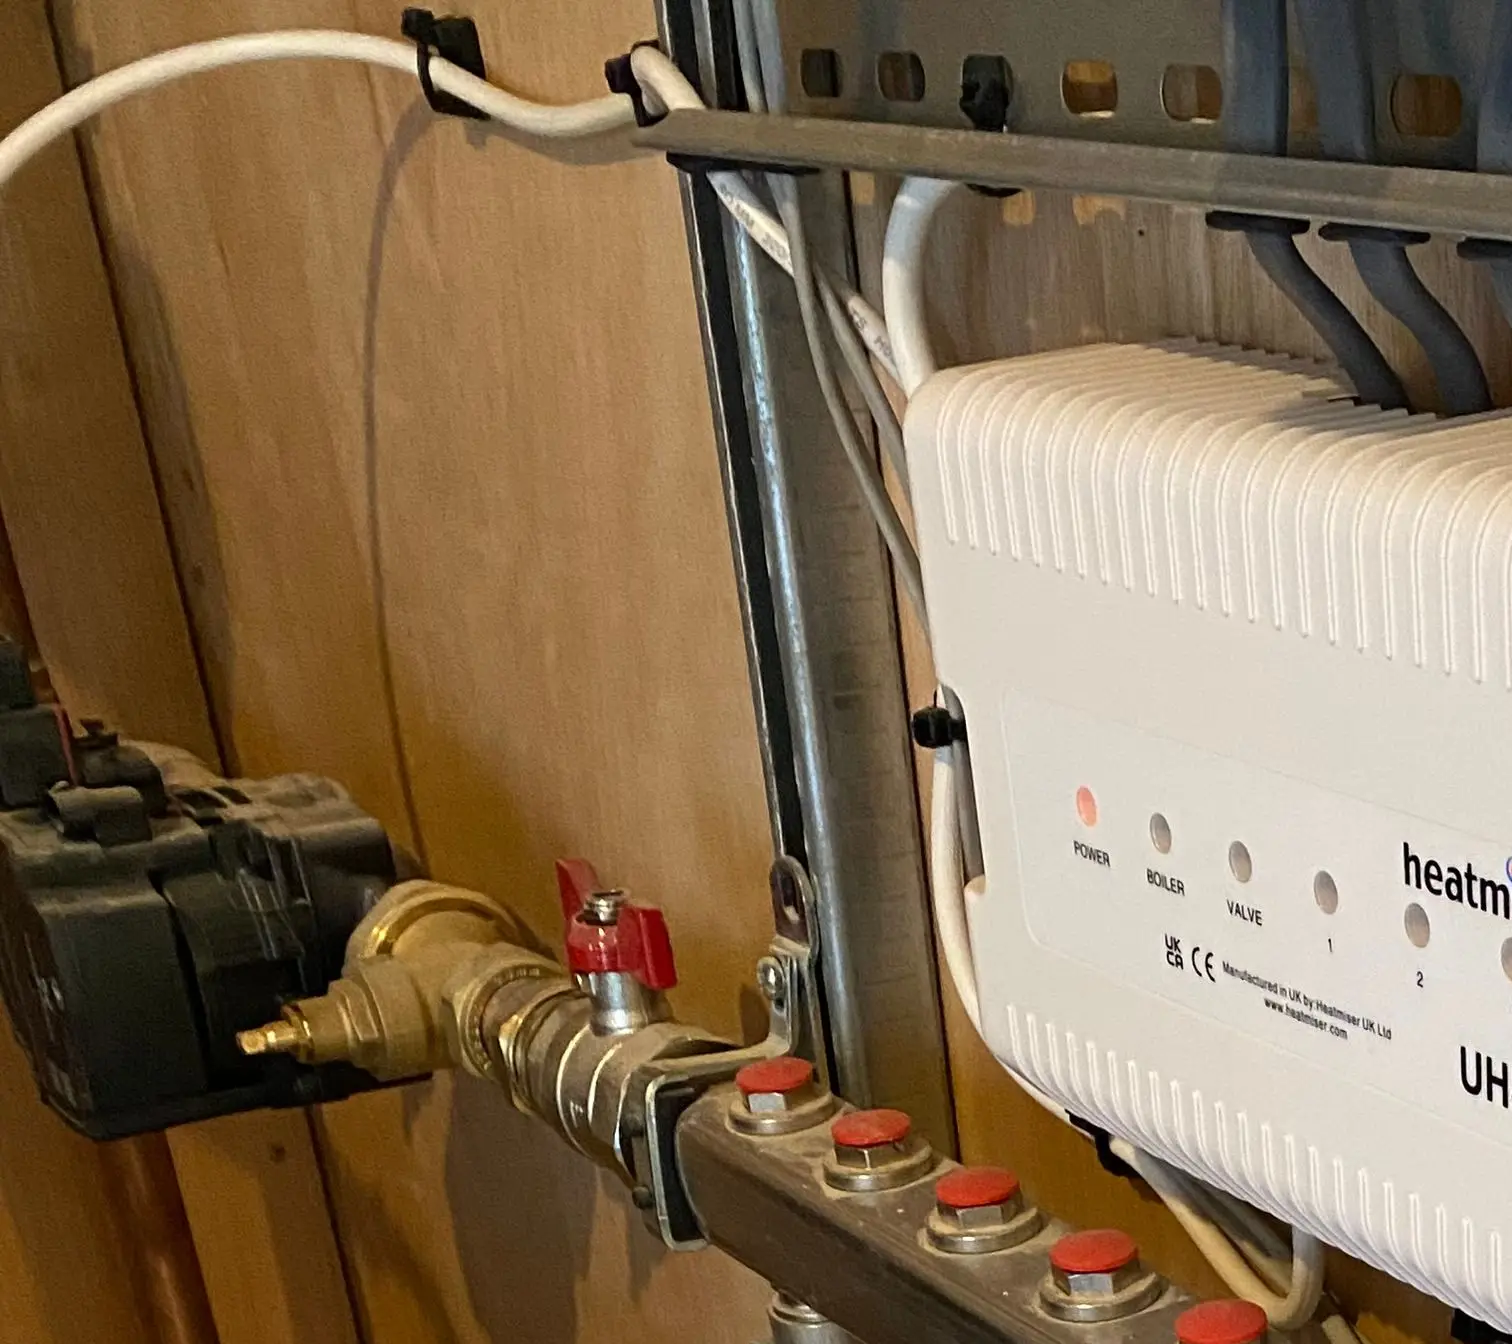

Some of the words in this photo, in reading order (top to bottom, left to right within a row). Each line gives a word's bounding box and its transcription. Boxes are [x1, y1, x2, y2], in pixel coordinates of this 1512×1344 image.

[1073, 840, 1112, 868] POWER
[1146, 867, 1185, 897] BOILER
[1226, 898, 1264, 928] VALVE
[1326, 937, 1334, 953] 1
[1415, 971, 1425, 988] 2
[1222, 960, 1278, 994] Manufactured
[1279, 985, 1288, 998] in
[1288, 988, 1301, 1003] UK
[1303, 994, 1314, 1011] by
[1316, 1000, 1360, 1027] Heatmiser
[1362, 1017, 1376, 1034] UK
[1377, 1023, 1392, 1040] Ltd
[1263, 998, 1348, 1040] www.heatmiser.com
